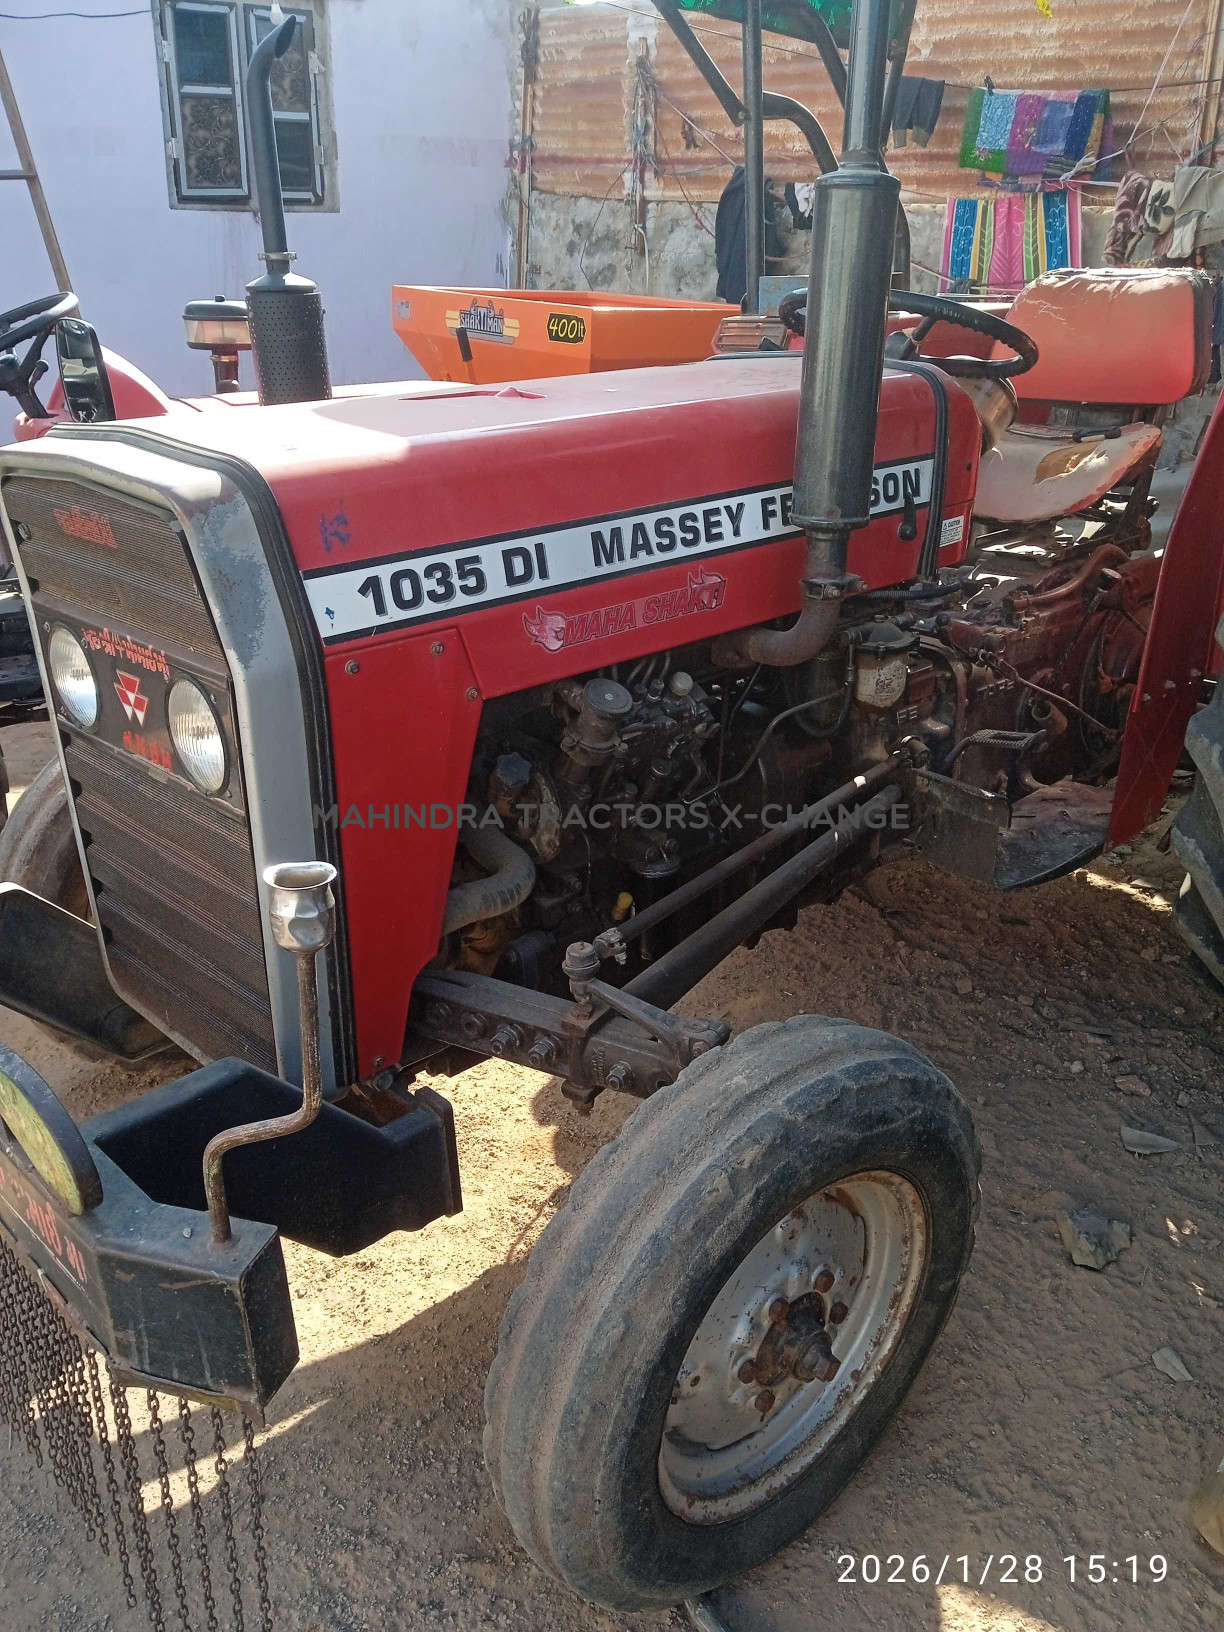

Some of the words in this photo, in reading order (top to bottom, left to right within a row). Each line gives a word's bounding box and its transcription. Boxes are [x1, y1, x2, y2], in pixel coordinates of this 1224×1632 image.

[460, 307, 503, 333] SHAKTIMAN
[357, 554, 488, 617] 1035
[501, 542, 550, 588] DI
[590, 503, 746, 568] MASSEY
[760, 467, 921, 531] FESON
[563, 602, 637, 647] MAHA
[642, 579, 726, 624] SHAKTI
